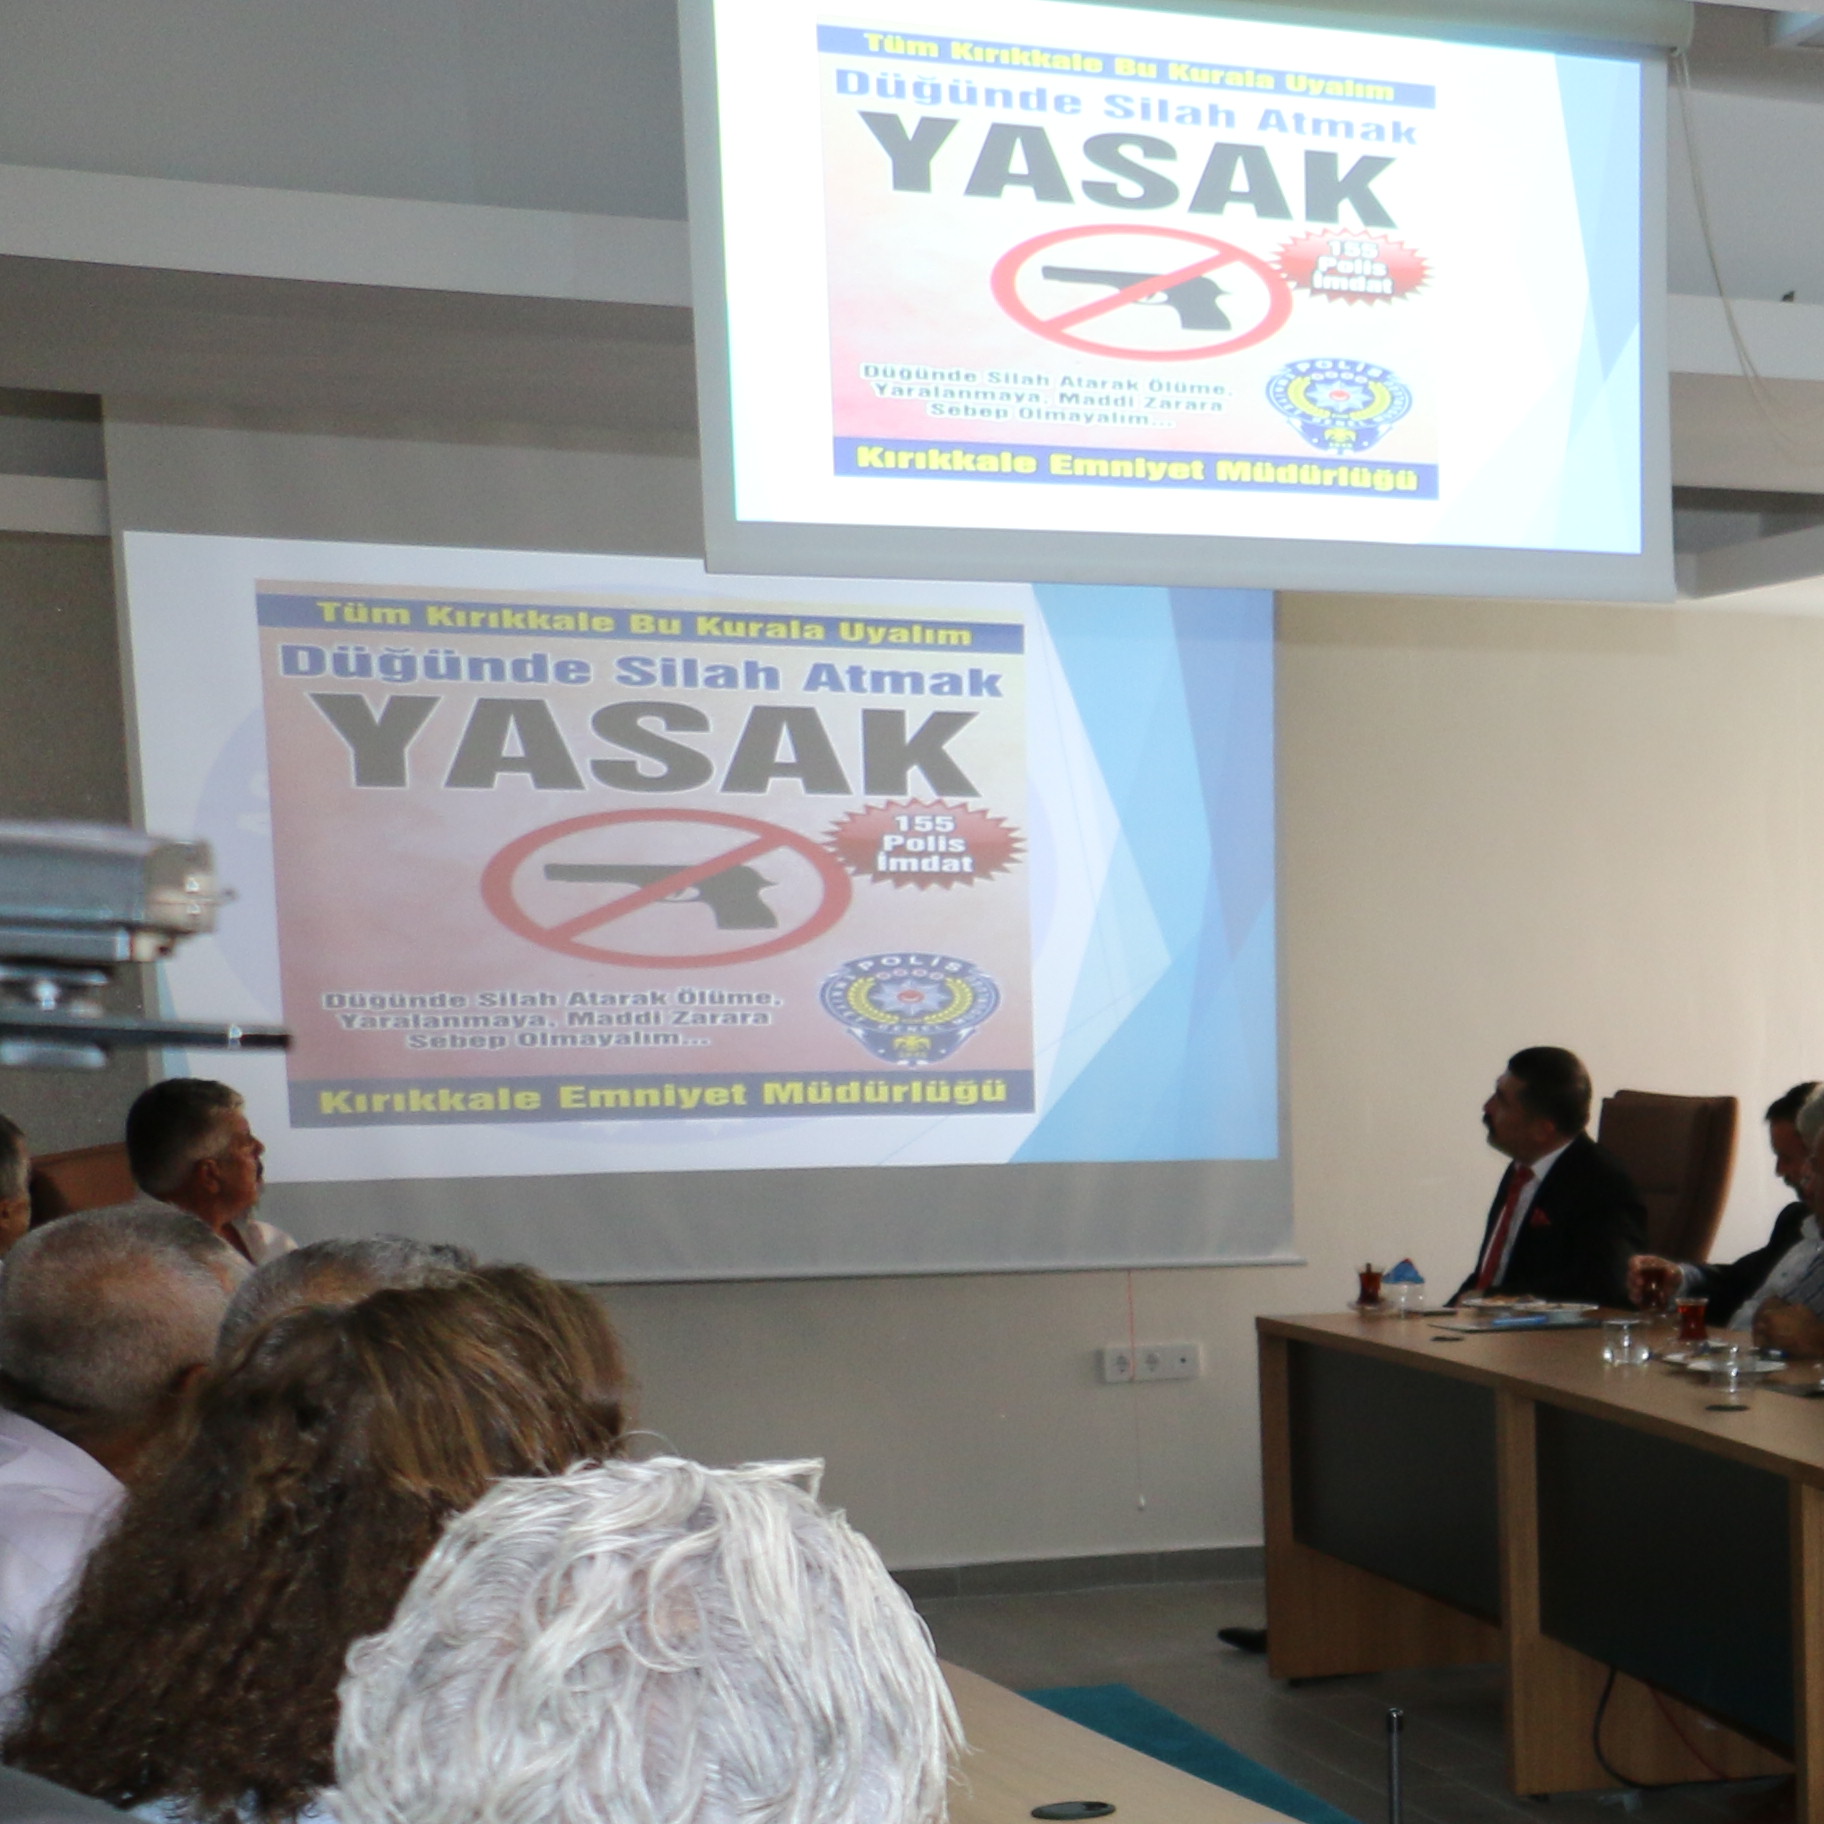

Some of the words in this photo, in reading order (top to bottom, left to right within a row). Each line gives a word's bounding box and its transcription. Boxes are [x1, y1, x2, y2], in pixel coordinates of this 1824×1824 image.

[864, 33, 939, 57] Tüm
[951, 41, 1103, 73] Kırıkkale
[1115, 56, 1157, 77] Bu
[1168, 63, 1275, 89] Kurala
[1286, 74, 1395, 101] Uyalım
[835, 69, 1082, 115] Düğünde
[1103, 94, 1236, 129] Silah
[1257, 108, 1418, 145] Atmak
[857, 110, 1398, 229] YASAK
[1327, 240, 1379, 258] 155
[1318, 256, 1388, 276] Polis
[987, 371, 1050, 387] Silah
[1060, 375, 1139, 392] Atarak
[930, 403, 1009, 420] Sebep
[1058, 392, 1140, 408] Maddi
[1143, 396, 1223, 413] Zarara
[856, 445, 1038, 474] Kırıkkale
[1049, 453, 1206, 481] Emniyet
[1216, 460, 1419, 492] Müdürlüğü
[317, 602, 411, 626] Tüm
[426, 604, 616, 633] Kırıkkale
[629, 613, 681, 635] Bu
[696, 616, 826, 642] Kurala
[839, 621, 973, 647] Uyalım
[279, 644, 593, 684] Düğünde
[615, 655, 781, 691] Silah
[802, 662, 1003, 698] Atmak
[308, 692, 983, 798] YASAK
[895, 815, 955, 832] 155
[883, 834, 967, 852] Polis
[876, 850, 974, 873] İmdat
[478, 991, 557, 1007] Silah
[568, 991, 668, 1006] Atarak
[567, 1011, 662, 1026] Maddi
[671, 1010, 771, 1026] Zarara
[408, 1033, 507, 1050] Sebep
[319, 1087, 542, 1114] Kırıkkale
[559, 1083, 748, 1109] Emniyet
[763, 1079, 1007, 1105] Müdürlüğü
